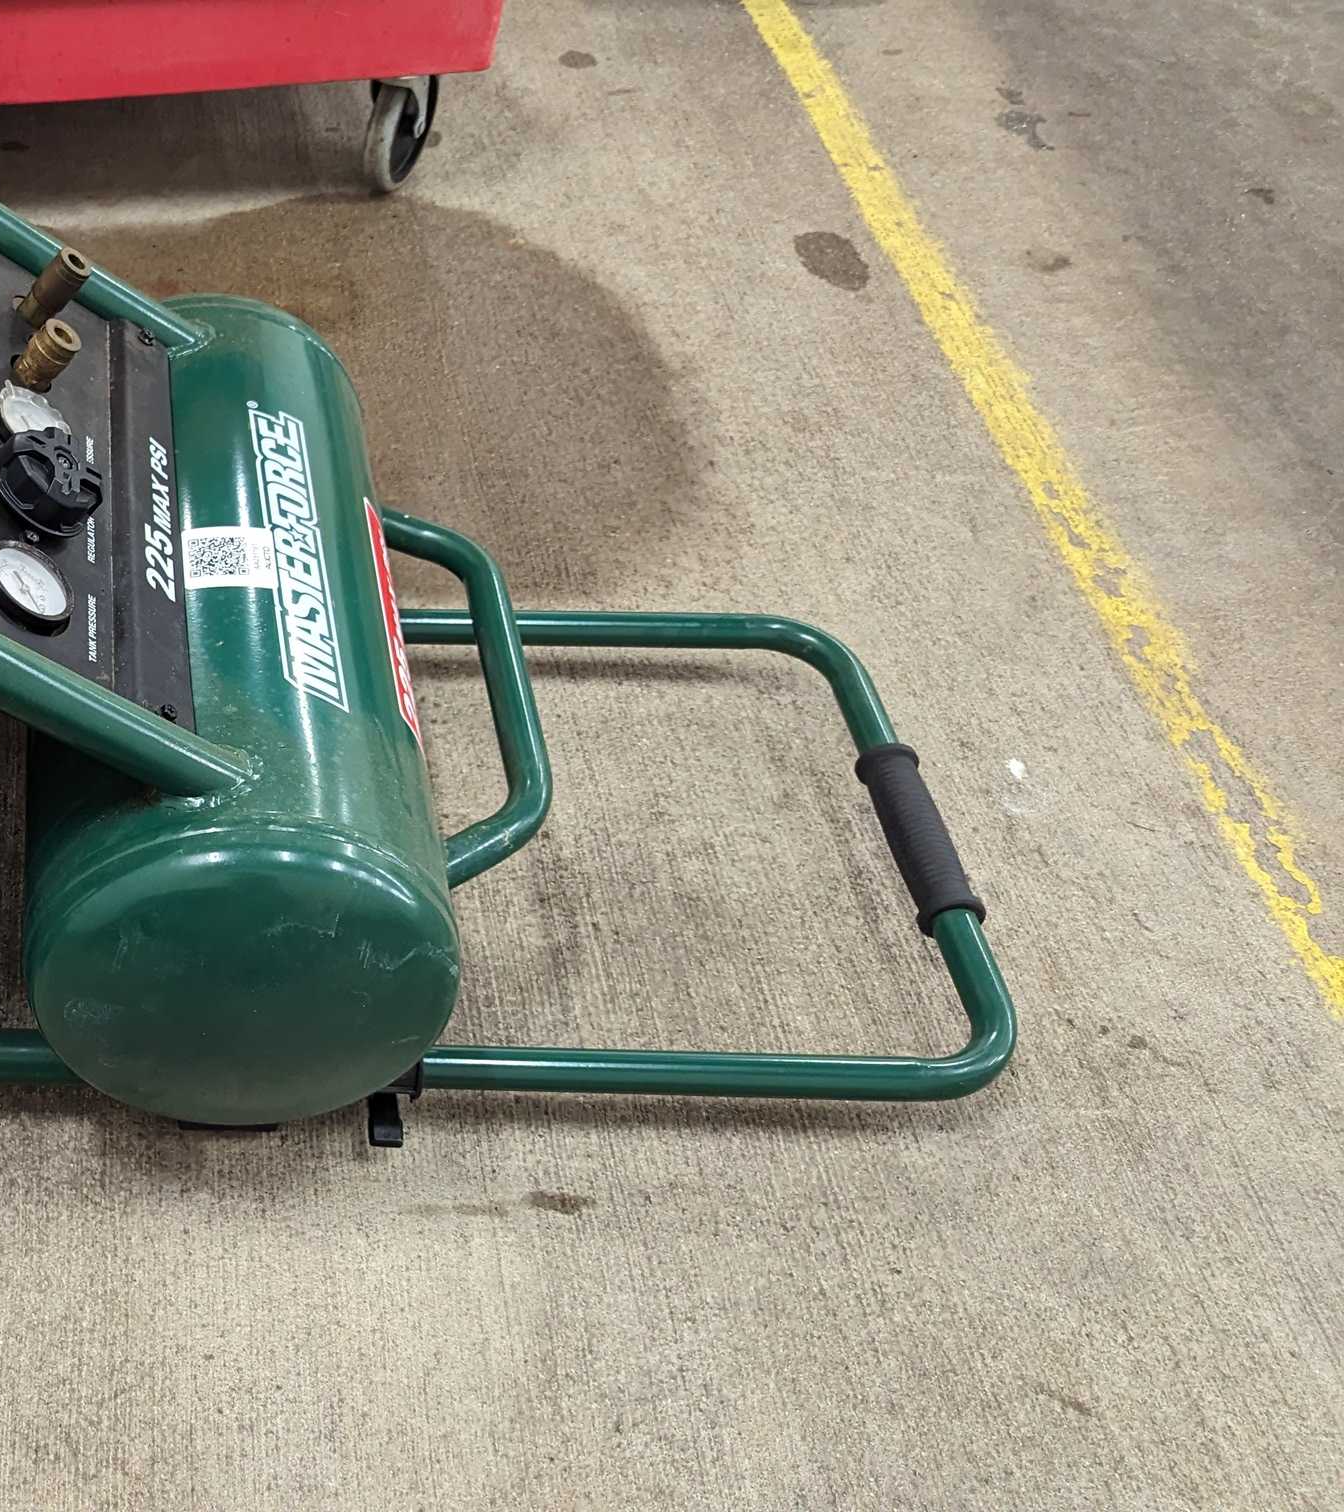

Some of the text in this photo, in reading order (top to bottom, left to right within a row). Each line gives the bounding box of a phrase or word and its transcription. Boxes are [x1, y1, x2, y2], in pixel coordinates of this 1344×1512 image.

[144, 436, 176, 602] 225 MAX PSI
[87, 594, 98, 663] TANK PRESSURE
